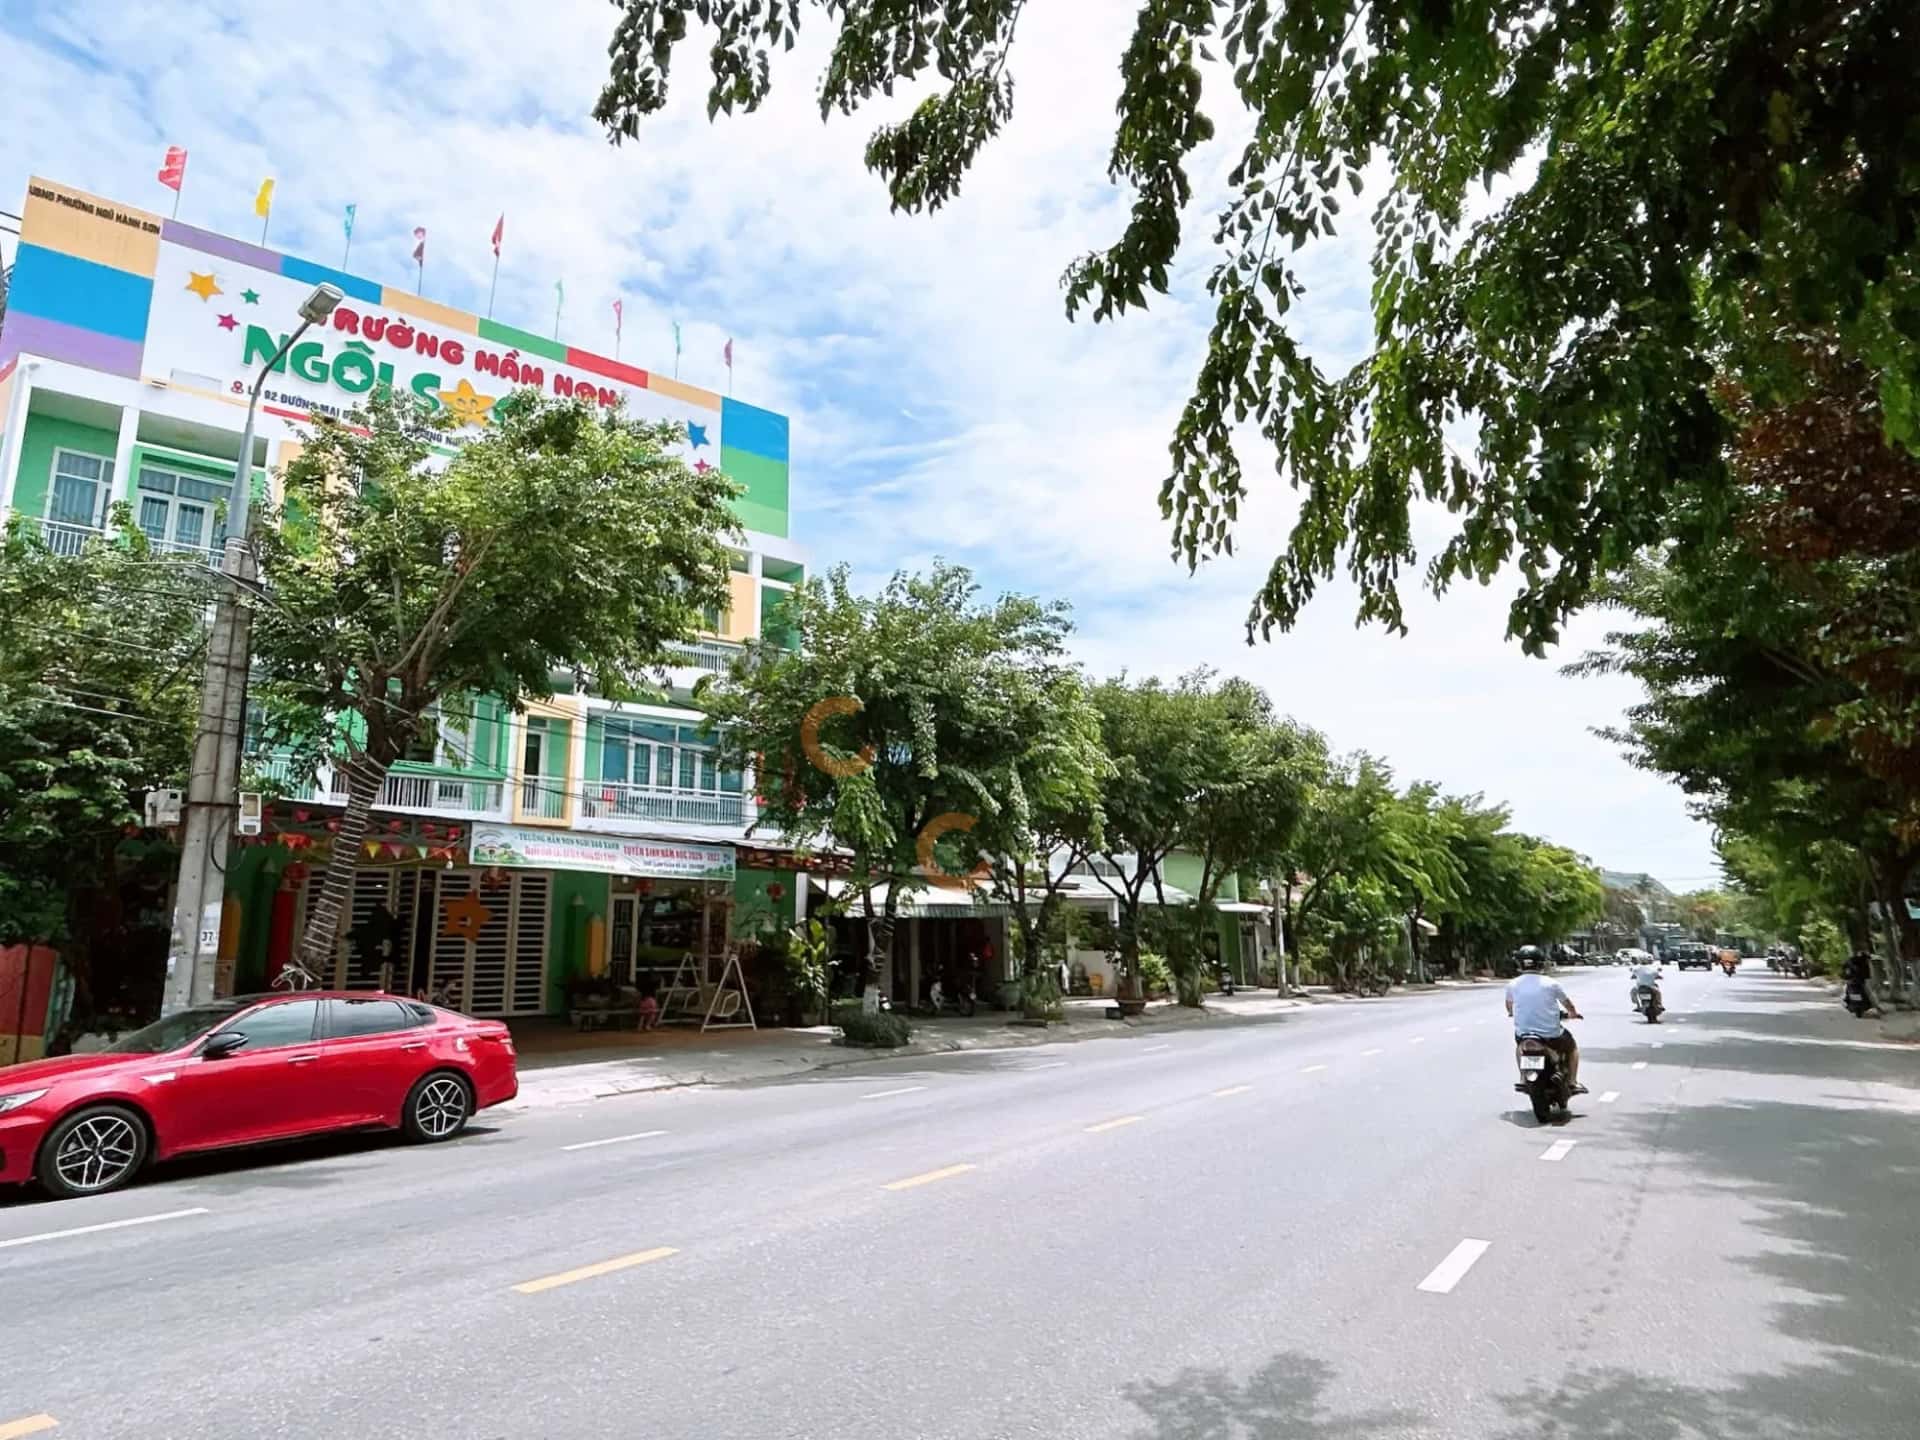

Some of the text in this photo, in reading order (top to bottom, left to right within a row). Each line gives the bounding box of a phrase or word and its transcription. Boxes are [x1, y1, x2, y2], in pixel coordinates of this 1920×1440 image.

[319, 307, 616, 408] RƯỜNG MẦM NON
